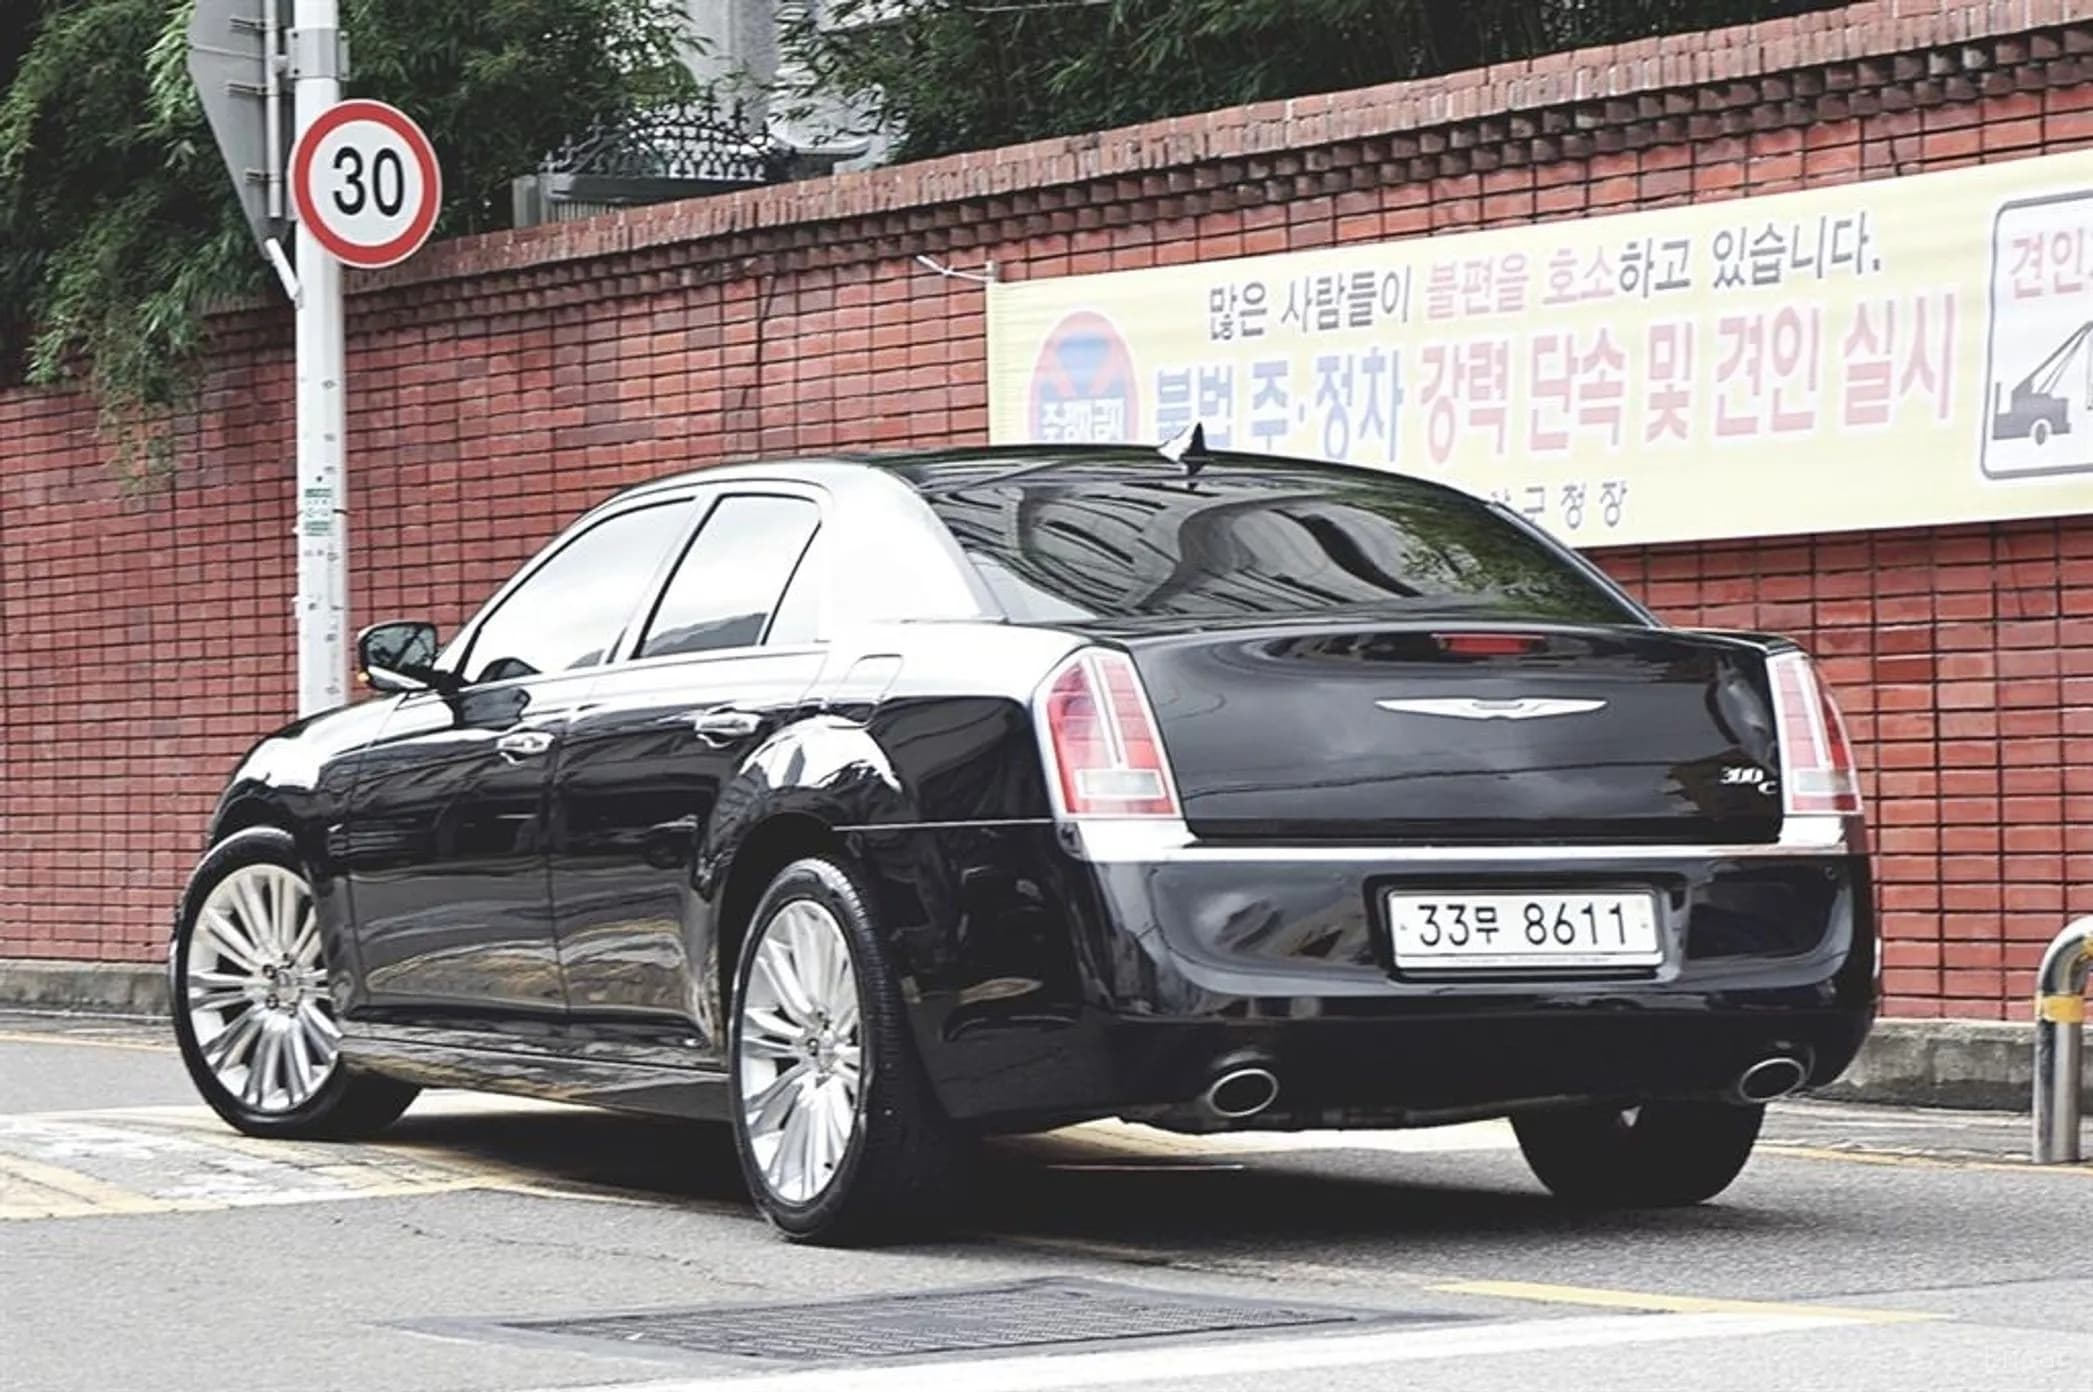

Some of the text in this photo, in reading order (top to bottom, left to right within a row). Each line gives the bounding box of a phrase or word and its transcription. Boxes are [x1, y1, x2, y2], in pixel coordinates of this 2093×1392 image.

[332, 145, 405, 217] 30
[1209, 211, 1881, 341] 많은 사람들이 불편을 호소하고 있습니다.
[2009, 226, 2093, 300] 견인
[1156, 365, 1232, 447] 불법
[1420, 340, 1510, 464] 강력
[1530, 328, 1627, 451] 단속
[1646, 322, 1694, 442] 및
[1715, 305, 1821, 437] 견인
[1842, 293, 1956, 426] 실시
[1417, 902, 1626, 947] 33무 8611
